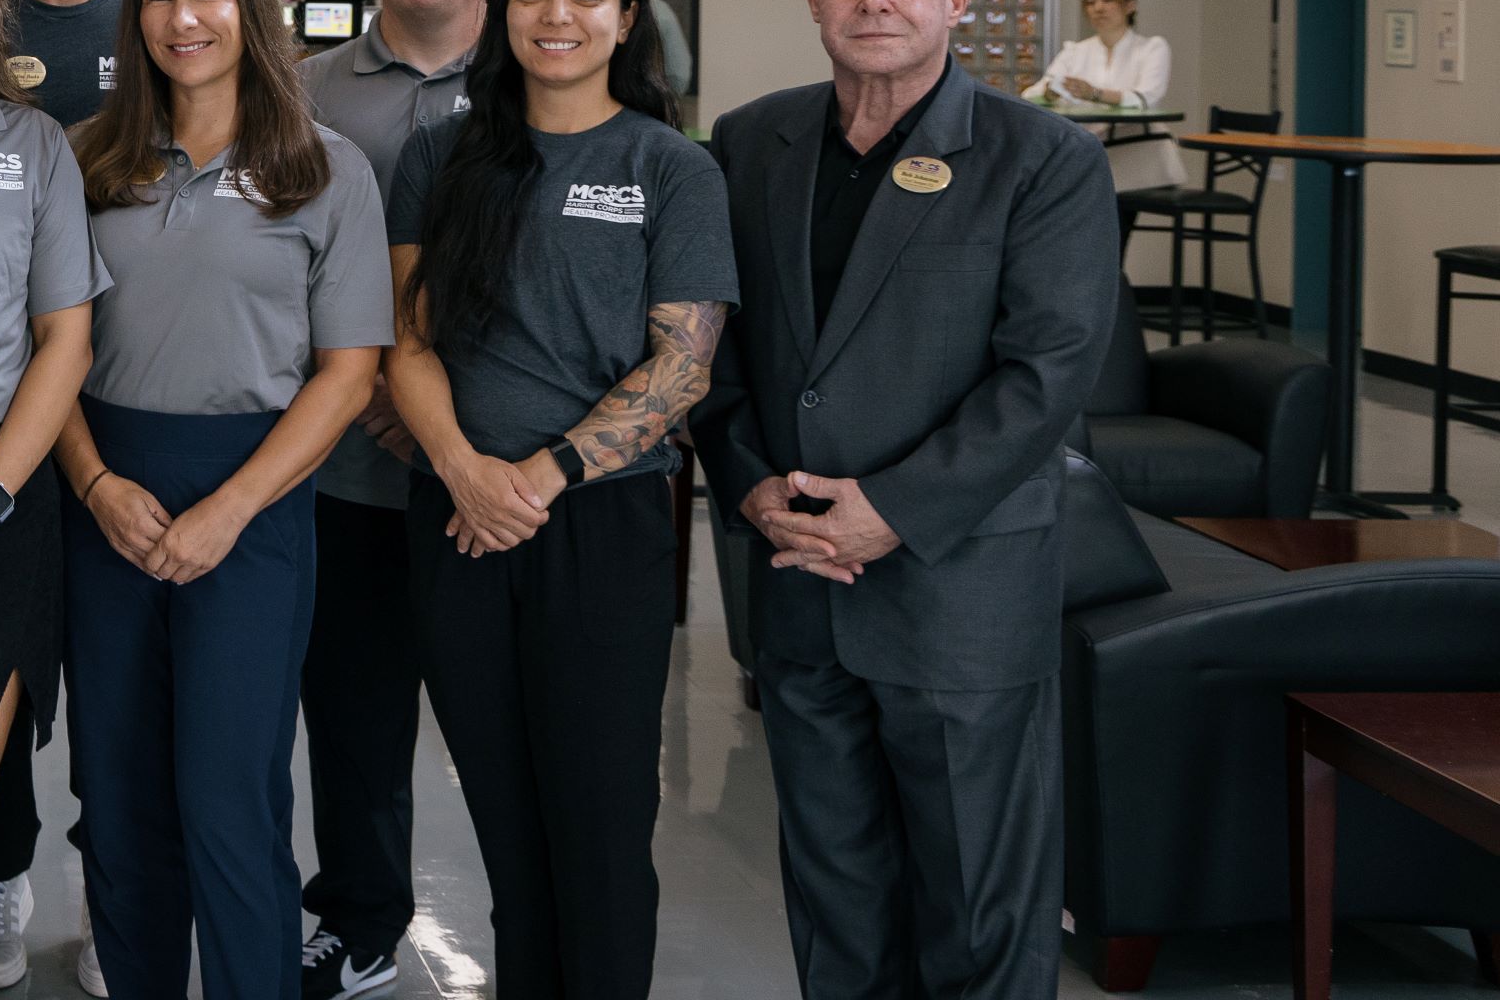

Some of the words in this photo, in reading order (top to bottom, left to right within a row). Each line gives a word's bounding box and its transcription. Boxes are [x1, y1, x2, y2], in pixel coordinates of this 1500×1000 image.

[567, 184, 645, 203] MCCS
[563, 208, 593, 216] HEALTH
[594, 211, 642, 222] PROMOTION
[596, 204, 624, 214] CORPS
